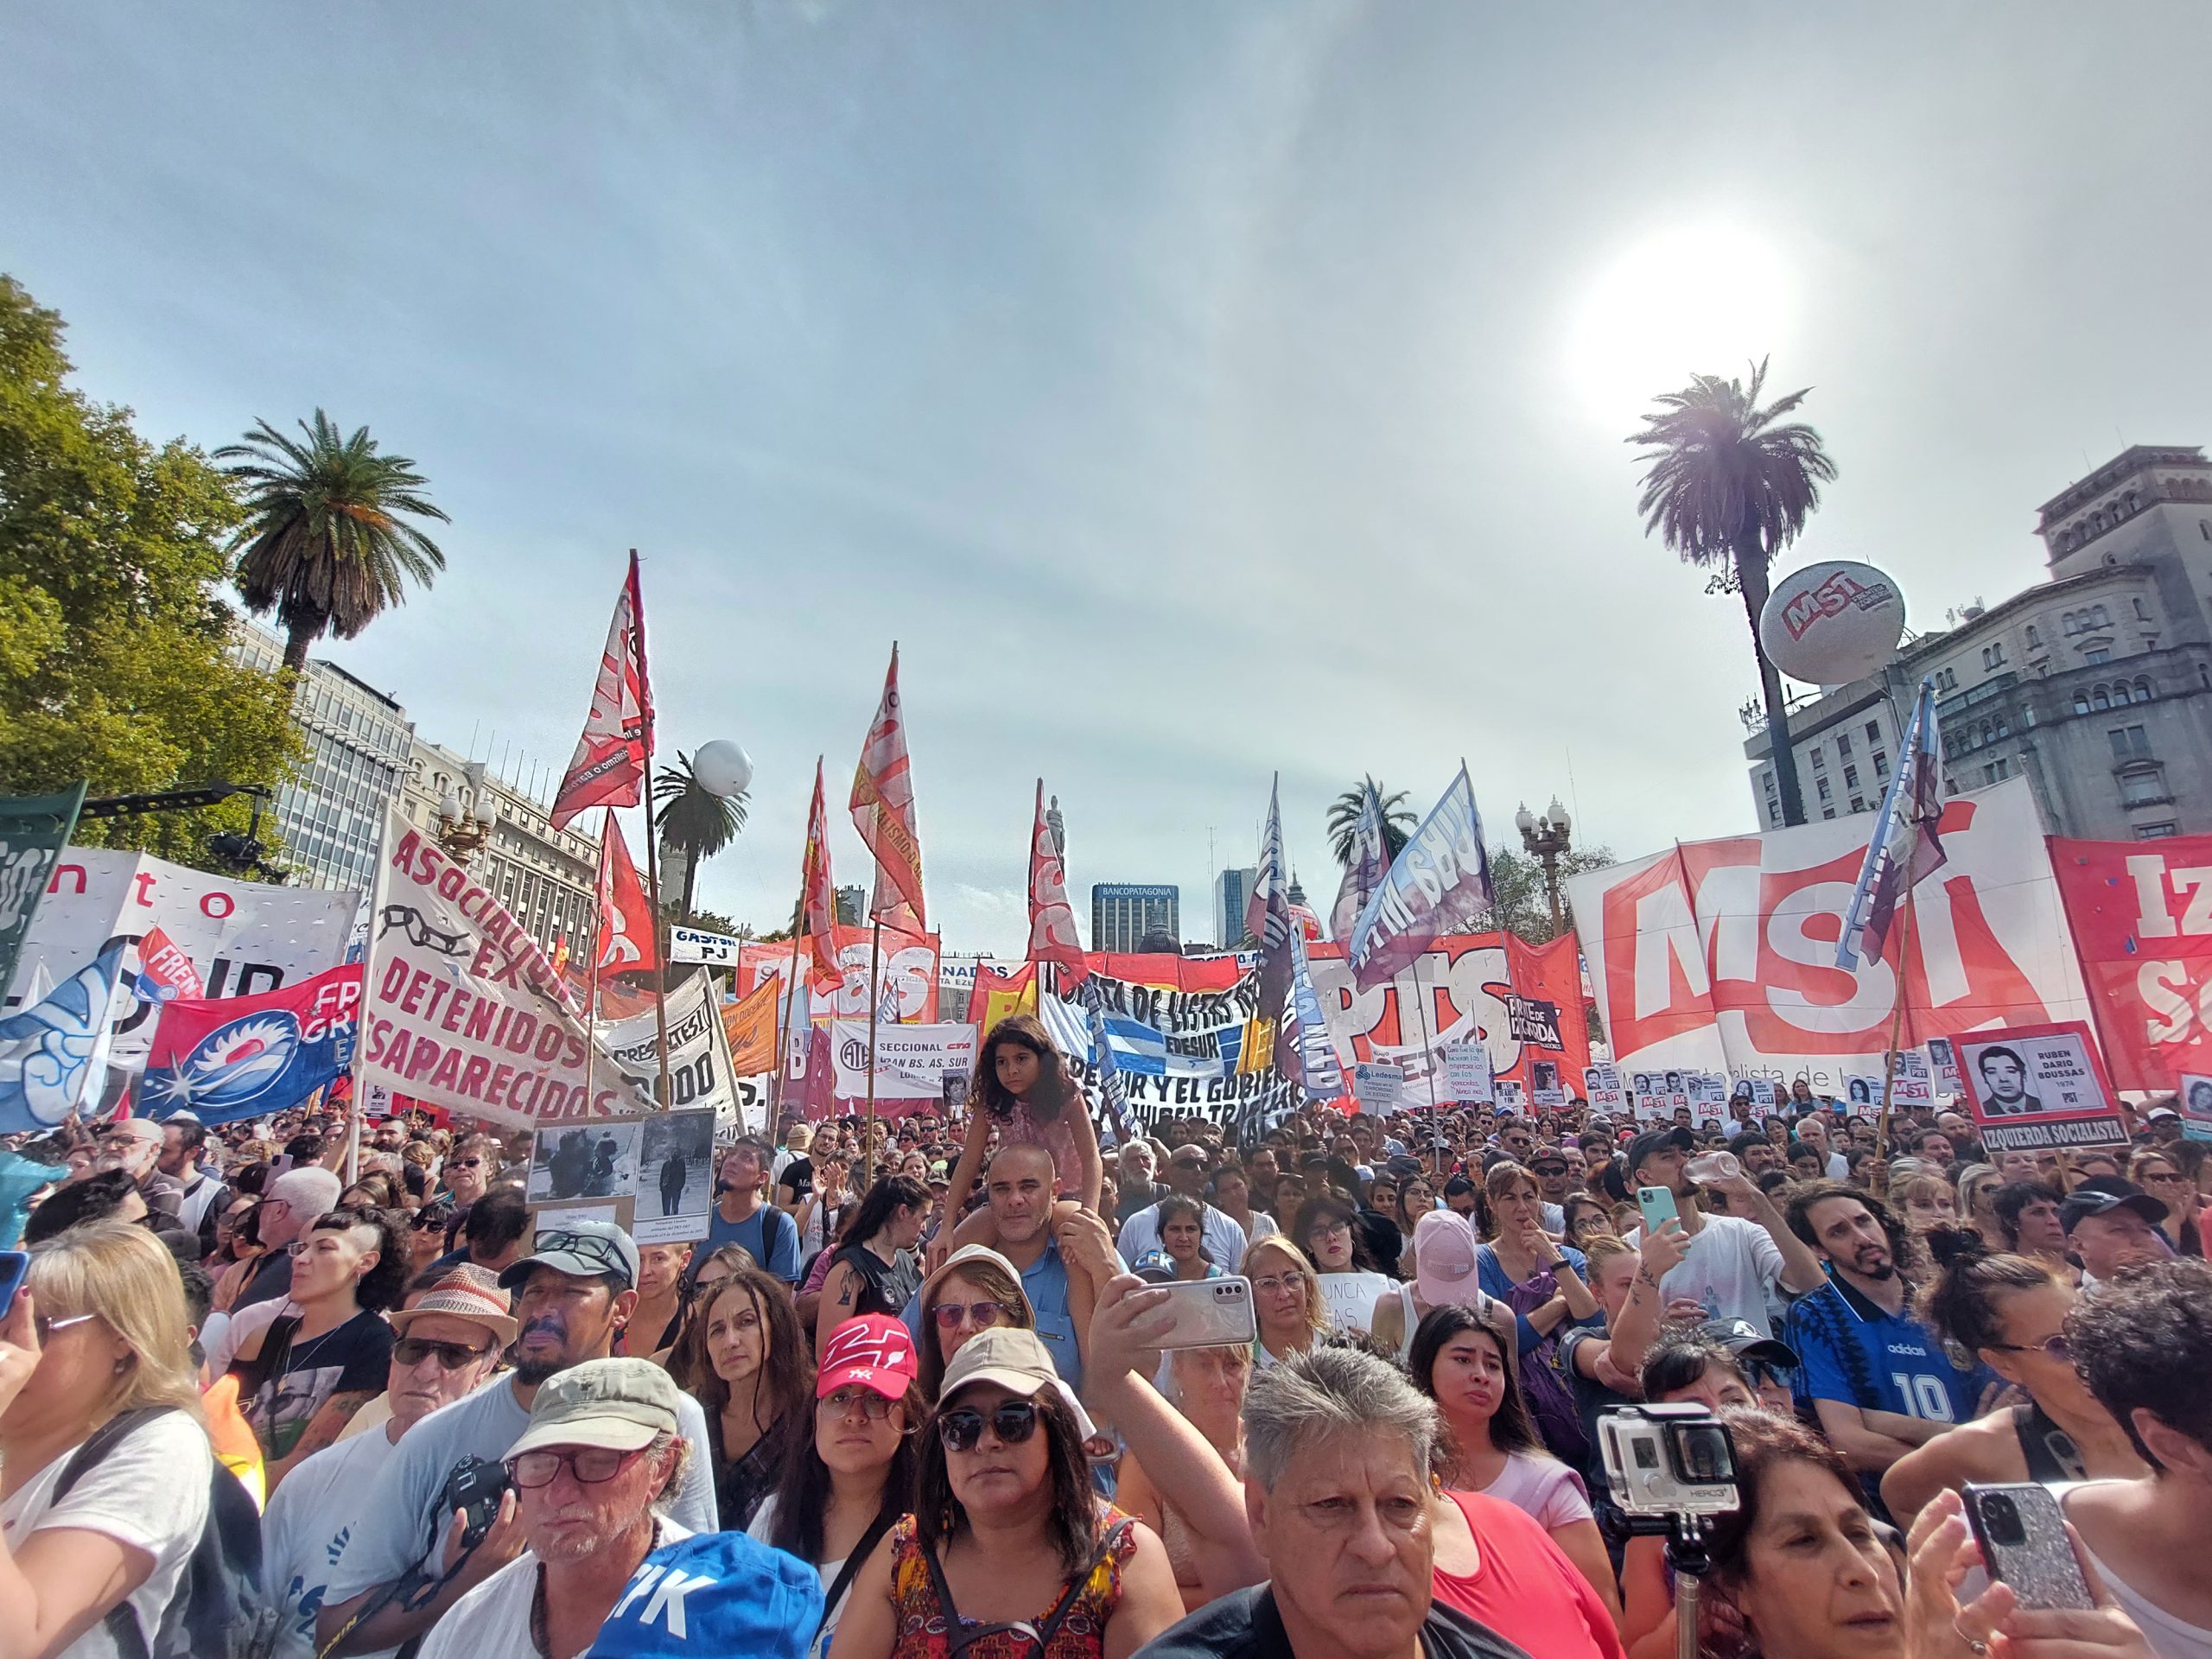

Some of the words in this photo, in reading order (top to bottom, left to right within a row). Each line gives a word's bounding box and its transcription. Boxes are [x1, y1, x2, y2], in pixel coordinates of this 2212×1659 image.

[1786, 573, 1858, 632] MST
[2126, 854, 2212, 939] IZ
[1626, 823, 1992, 1040] MST
[701, 947, 728, 959] PJ
[149, 944, 200, 995] FREN
[469, 938, 520, 990] EX
[955, 978, 974, 988] EZE
[315, 981, 361, 1013] FR
[378, 957, 587, 1070] DETENIDOS
[1308, 947, 1523, 1076] PTS
[880, 1043, 942, 1052] SECCIONAL
[1164, 1032, 1220, 1058] EDESUR
[2037, 1050, 2071, 1060] RUBEN
[909, 1058, 925, 1069] BS.
[929, 1058, 945, 1068] AS.
[948, 1057, 969, 1067] SUR
[2043, 1059, 2074, 1069] DARIO
[1371, 1070, 1402, 1081] Ledesma
[1796, 1064, 1829, 1087] de
[1911, 1068, 1928, 1077] PST
[2038, 1068, 2085, 1080] BOUSSAS
[1154, 1074, 1173, 1102] Y
[1175, 1077, 1200, 1104] EL
[1892, 1081, 1929, 1097] MST
[1596, 1091, 1618, 1103] MST
[1643, 1096, 1666, 1108] MST
[1712, 1092, 1725, 1101] PST
[1759, 1095, 1774, 1103] PST
[2063, 1091, 2079, 1103] PST
[1699, 1103, 1723, 1116] MST
[1984, 1127, 2052, 1151] IZQUIERDA
[2052, 1120, 2123, 1142] SOCIALISTA
[798, 1178, 811, 1187] Ma
[1135, 1251, 1174, 1273] CFK
[1331, 1307, 1358, 1332] AS
[1887, 1343, 1926, 1357] adidas
[1891, 1372, 1955, 1424] 10
